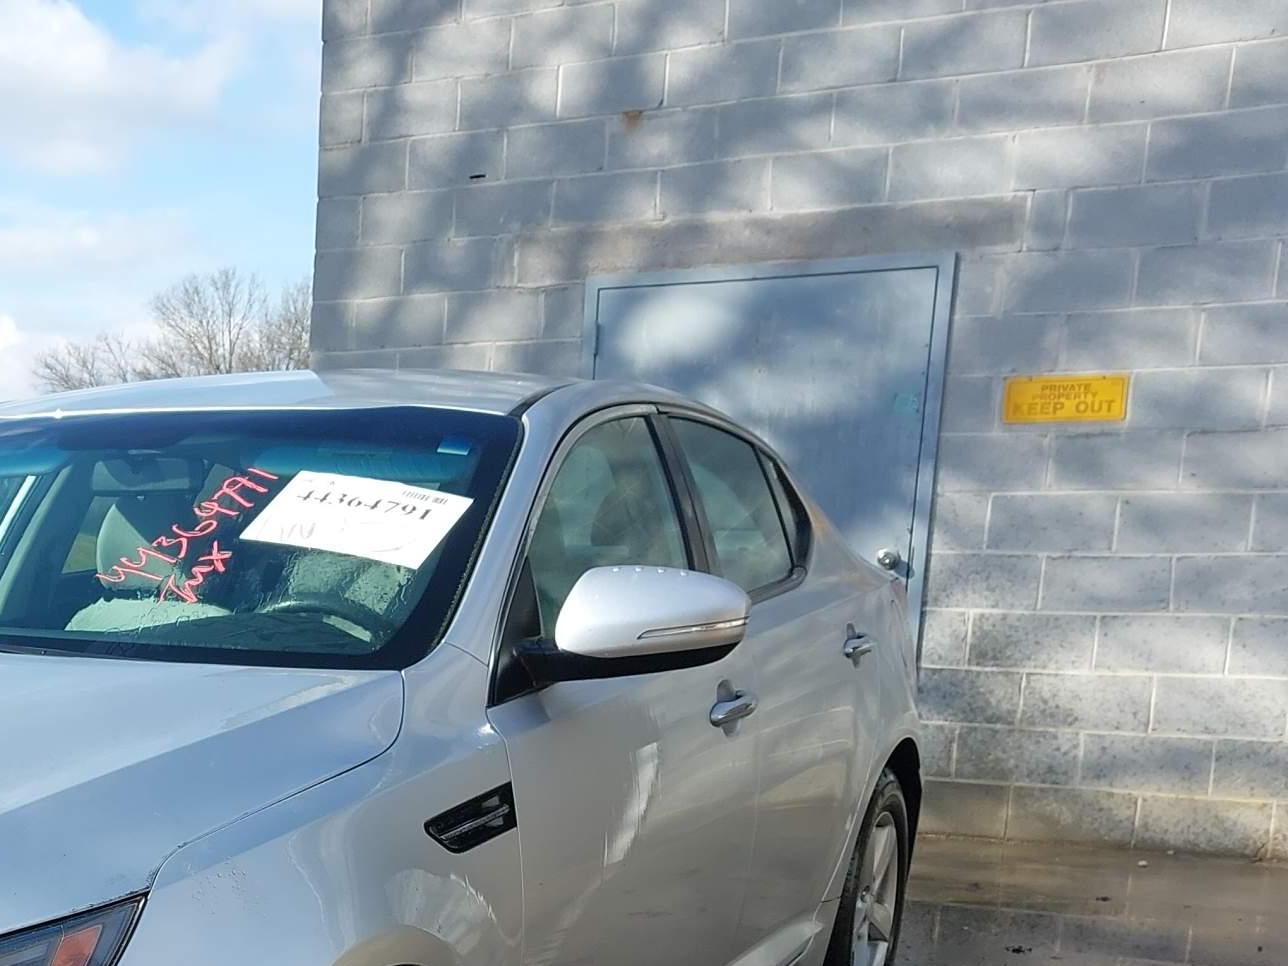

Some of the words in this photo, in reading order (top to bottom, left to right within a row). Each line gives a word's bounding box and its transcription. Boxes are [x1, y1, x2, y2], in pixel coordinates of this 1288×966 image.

[1041, 383, 1092, 392] PRIVATE
[1032, 391, 1098, 401] PROPERTY
[1012, 401, 1065, 416] KEEP
[1075, 400, 1116, 414] OUT
[296, 488, 433, 521] 44364791
